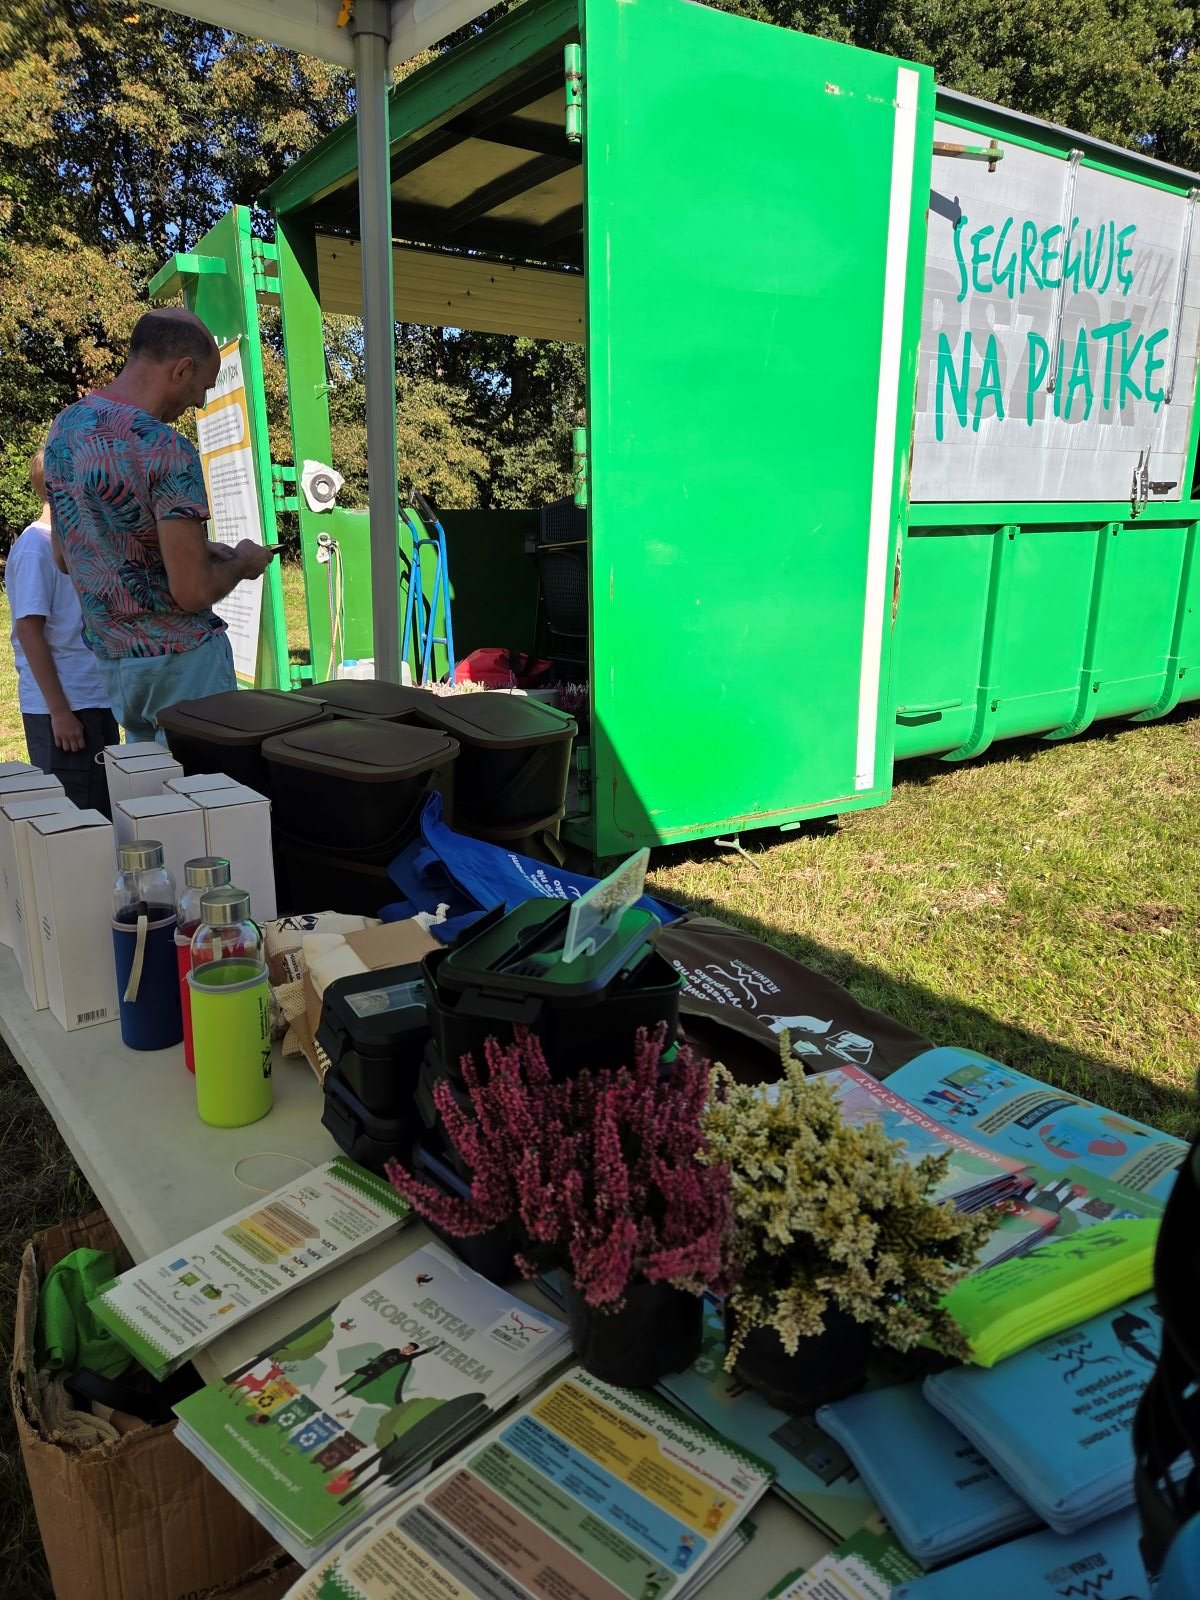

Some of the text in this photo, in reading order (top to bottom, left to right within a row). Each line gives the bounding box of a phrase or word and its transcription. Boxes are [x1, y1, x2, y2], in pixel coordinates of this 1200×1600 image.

[953, 215, 1136, 302] SEGREGUJĘ
[935, 331, 1005, 441] NA
[686, 973, 701, 986] to
[702, 982, 725, 1004] asto
[856, 1074, 940, 1133] EDUKACYJNY
[943, 1130, 1002, 1163] KOMIKS
[358, 1287, 495, 1384] EKOBOHATEREM
[410, 1296, 477, 1343] JESTEM
[572, 1370, 593, 1389] Jak
[590, 1381, 656, 1429] segregować
[654, 1420, 706, 1460] odpady?
